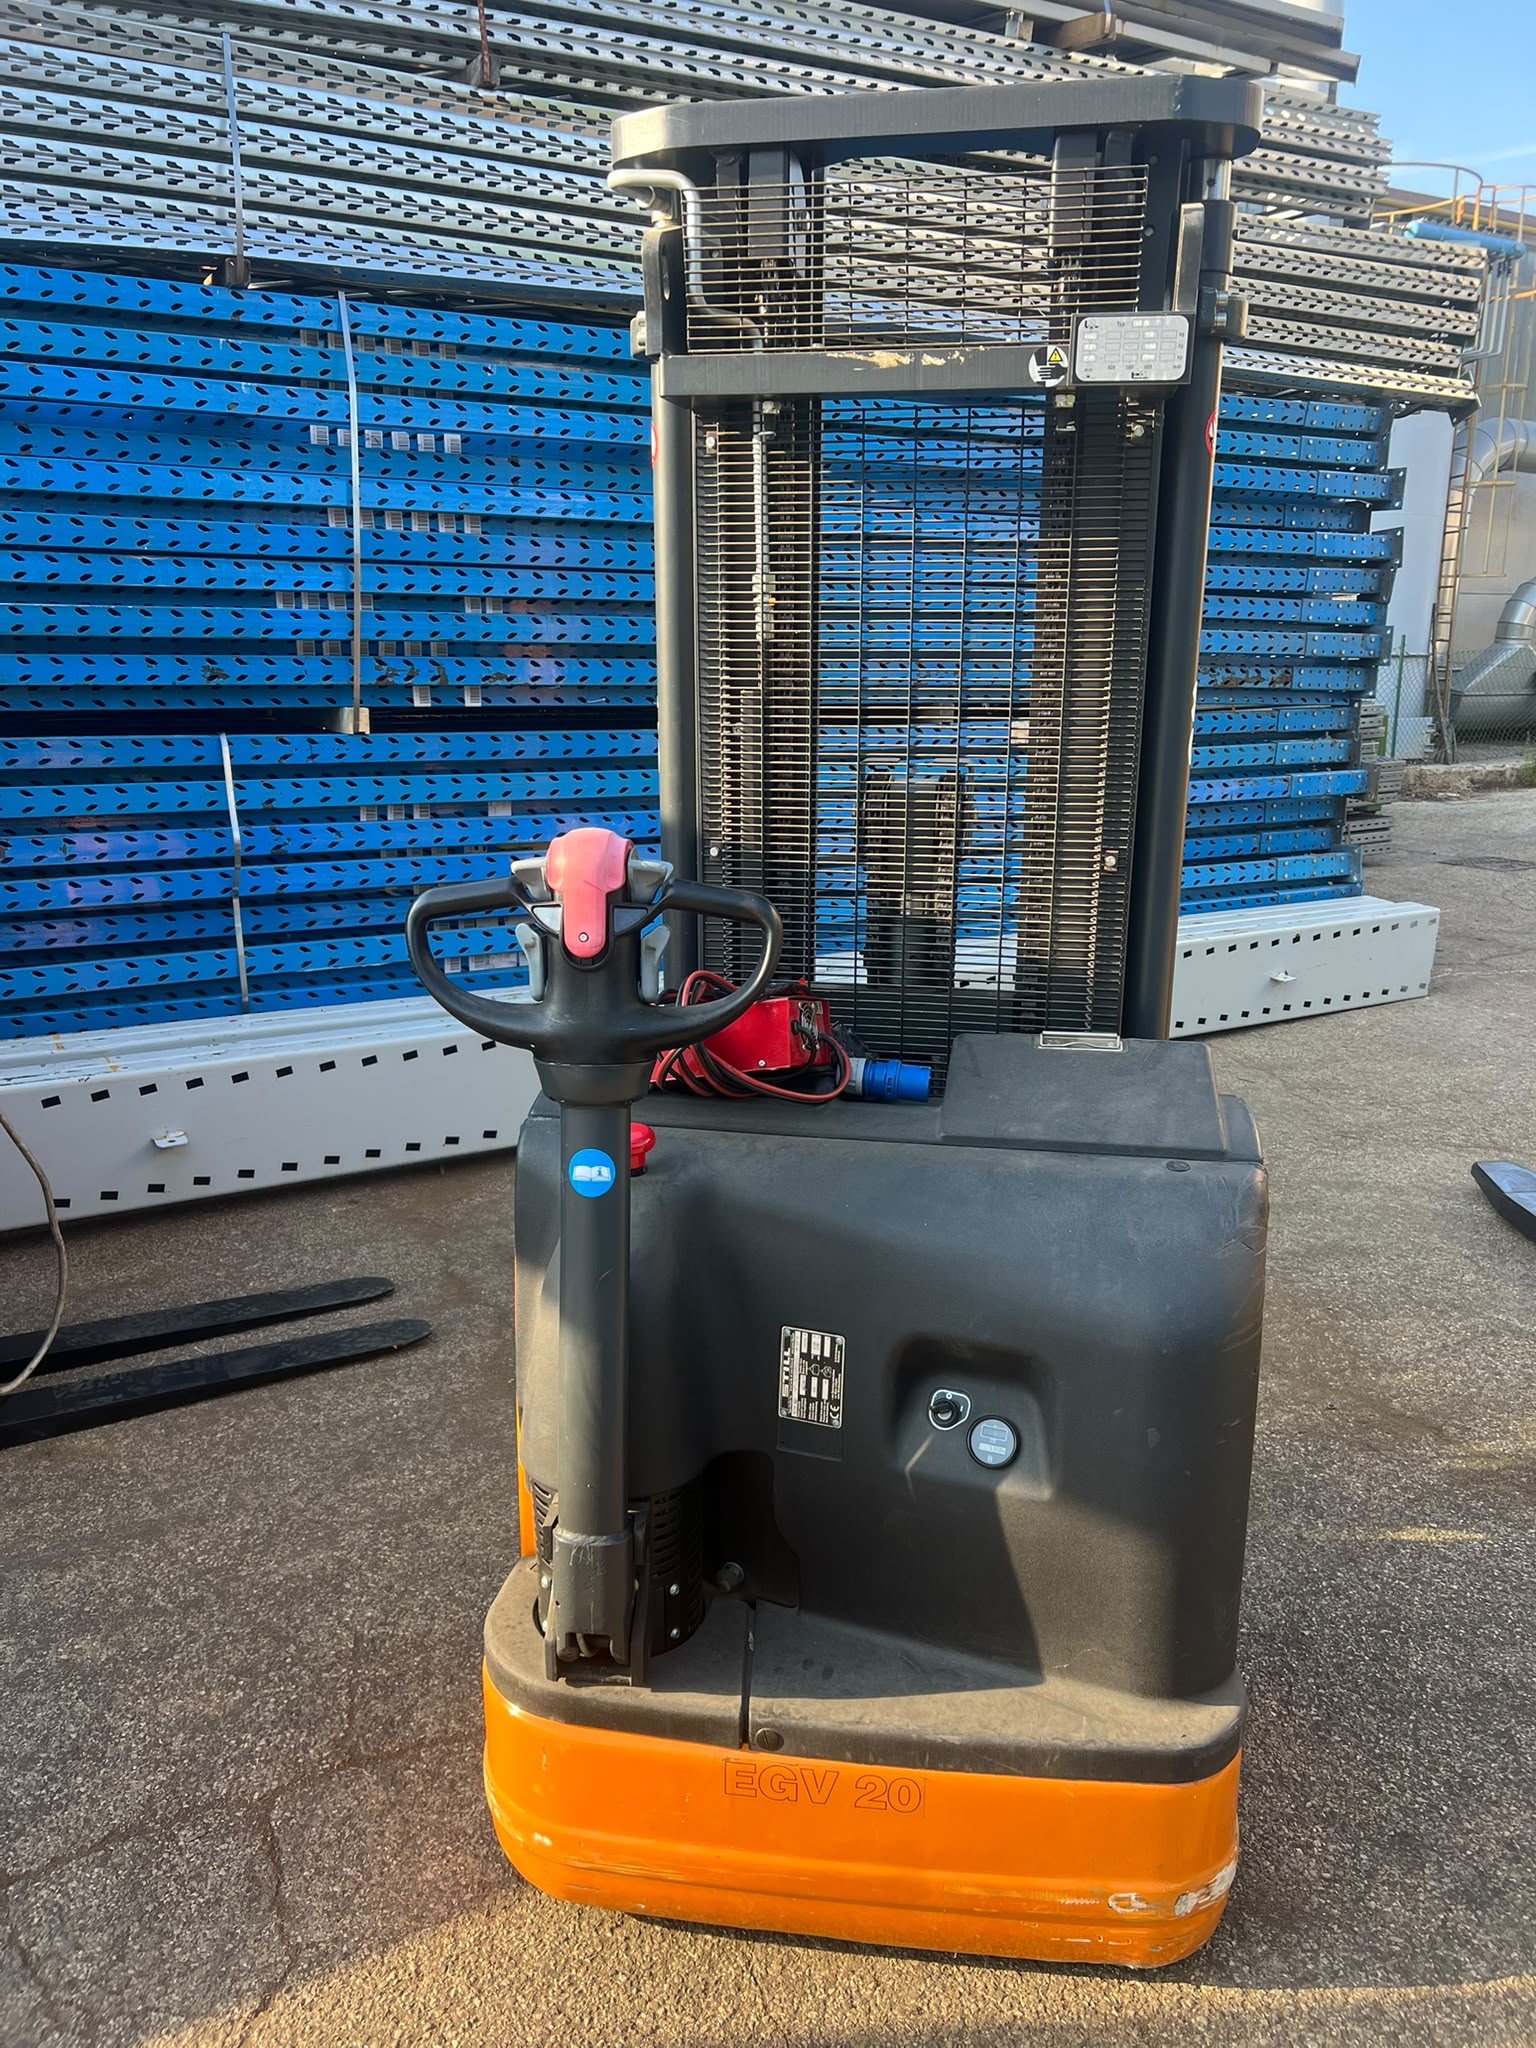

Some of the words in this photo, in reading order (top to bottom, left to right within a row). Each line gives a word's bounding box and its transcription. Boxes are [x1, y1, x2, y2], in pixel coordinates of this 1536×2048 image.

[782, 1347, 791, 1398] STILL
[724, 1761, 839, 1804] EGV
[854, 1774, 922, 1813] 20
